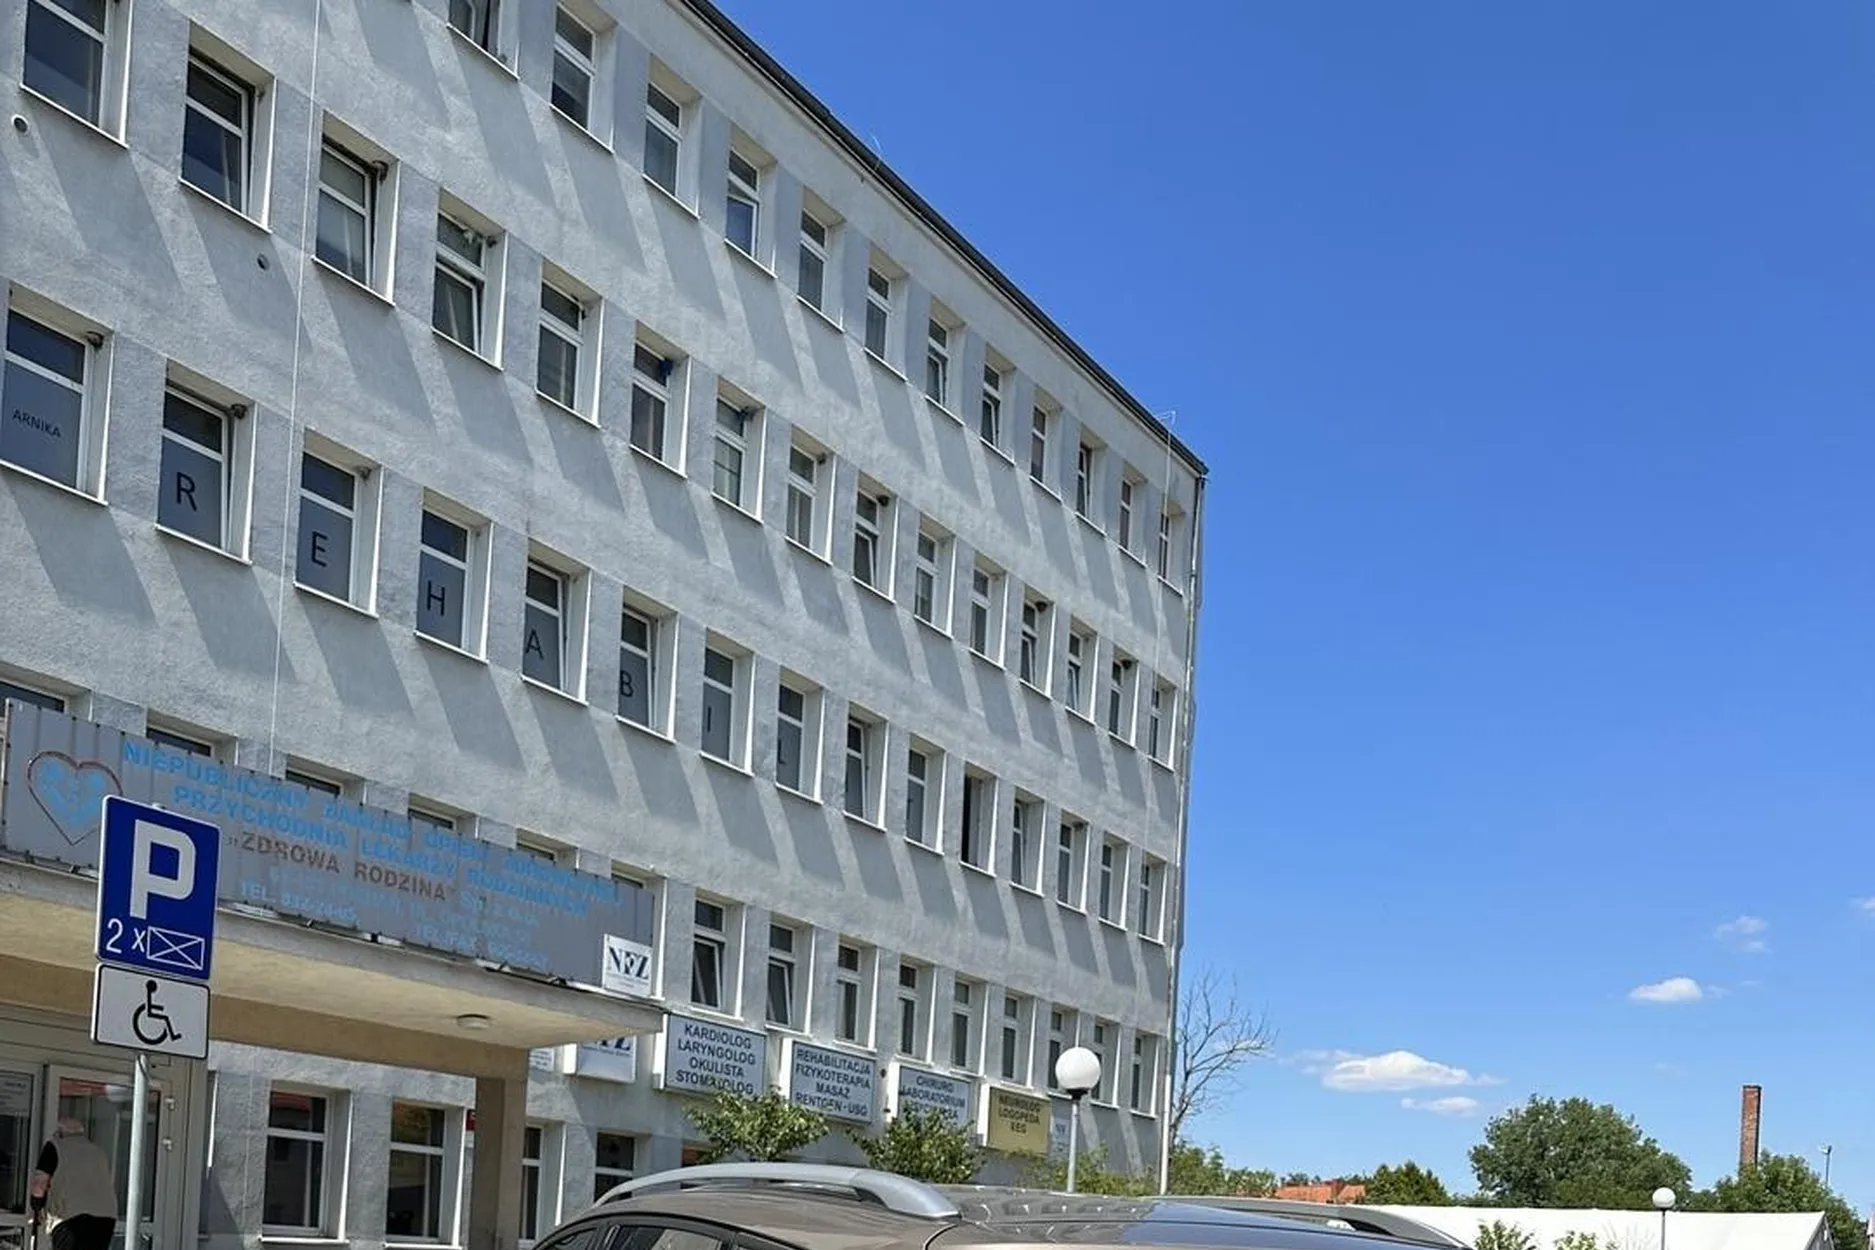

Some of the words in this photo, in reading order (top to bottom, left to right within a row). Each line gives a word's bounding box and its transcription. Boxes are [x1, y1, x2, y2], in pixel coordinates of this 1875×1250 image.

[12, 409, 61, 439] ARNIKA
[176, 471, 198, 512] R
[311, 530, 328, 568] E
[426, 579, 446, 617] H
[525, 628, 544, 660] A
[129, 818, 197, 920] P
[106, 917, 123, 954] 2
[608, 946, 649, 979] NFZ
[684, 1023, 752, 1050] KARDIOLOG
[677, 1038, 756, 1065] LARYNGOLOG
[796, 1048, 871, 1075] REHABILITACJA
[689, 1056, 745, 1078] OKULISTA
[795, 1063, 872, 1090] FIZYKOTERAPIA
